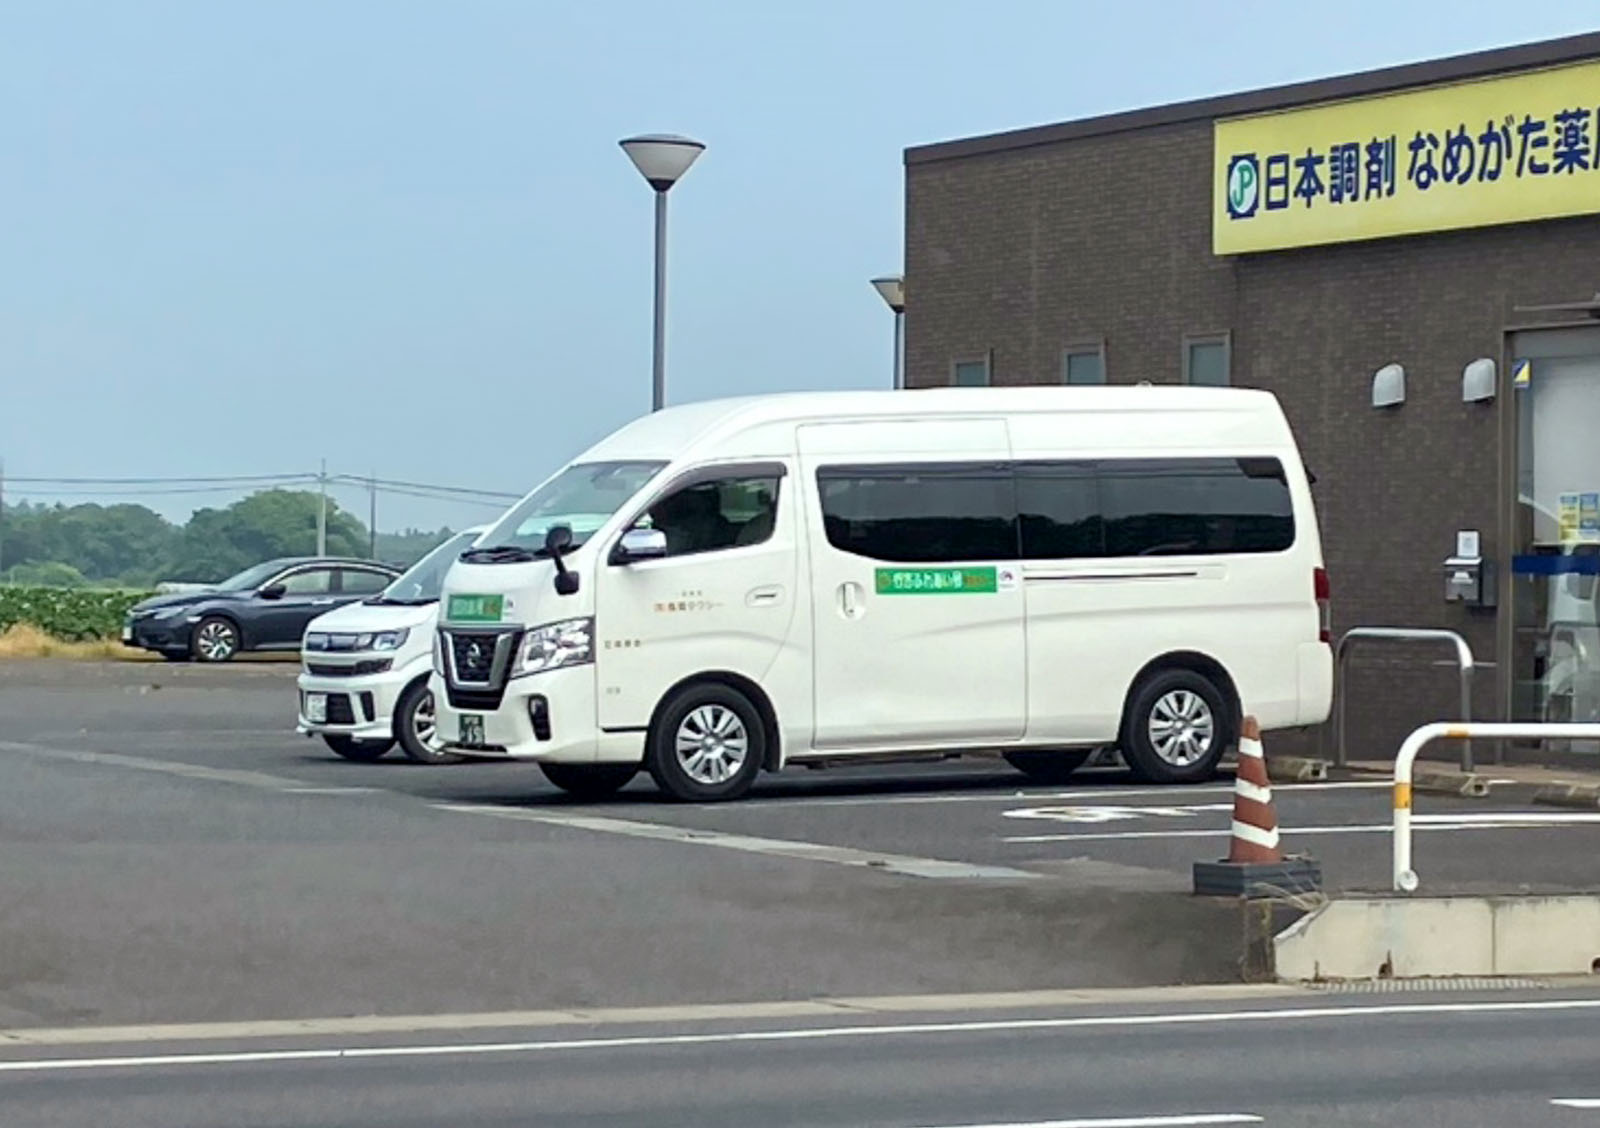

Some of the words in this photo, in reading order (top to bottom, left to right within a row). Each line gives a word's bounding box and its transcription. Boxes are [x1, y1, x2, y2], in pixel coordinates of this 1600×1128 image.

[1265, 134, 1396, 210] 日本調剤
[1407, 106, 1600, 190] なめがた薬
